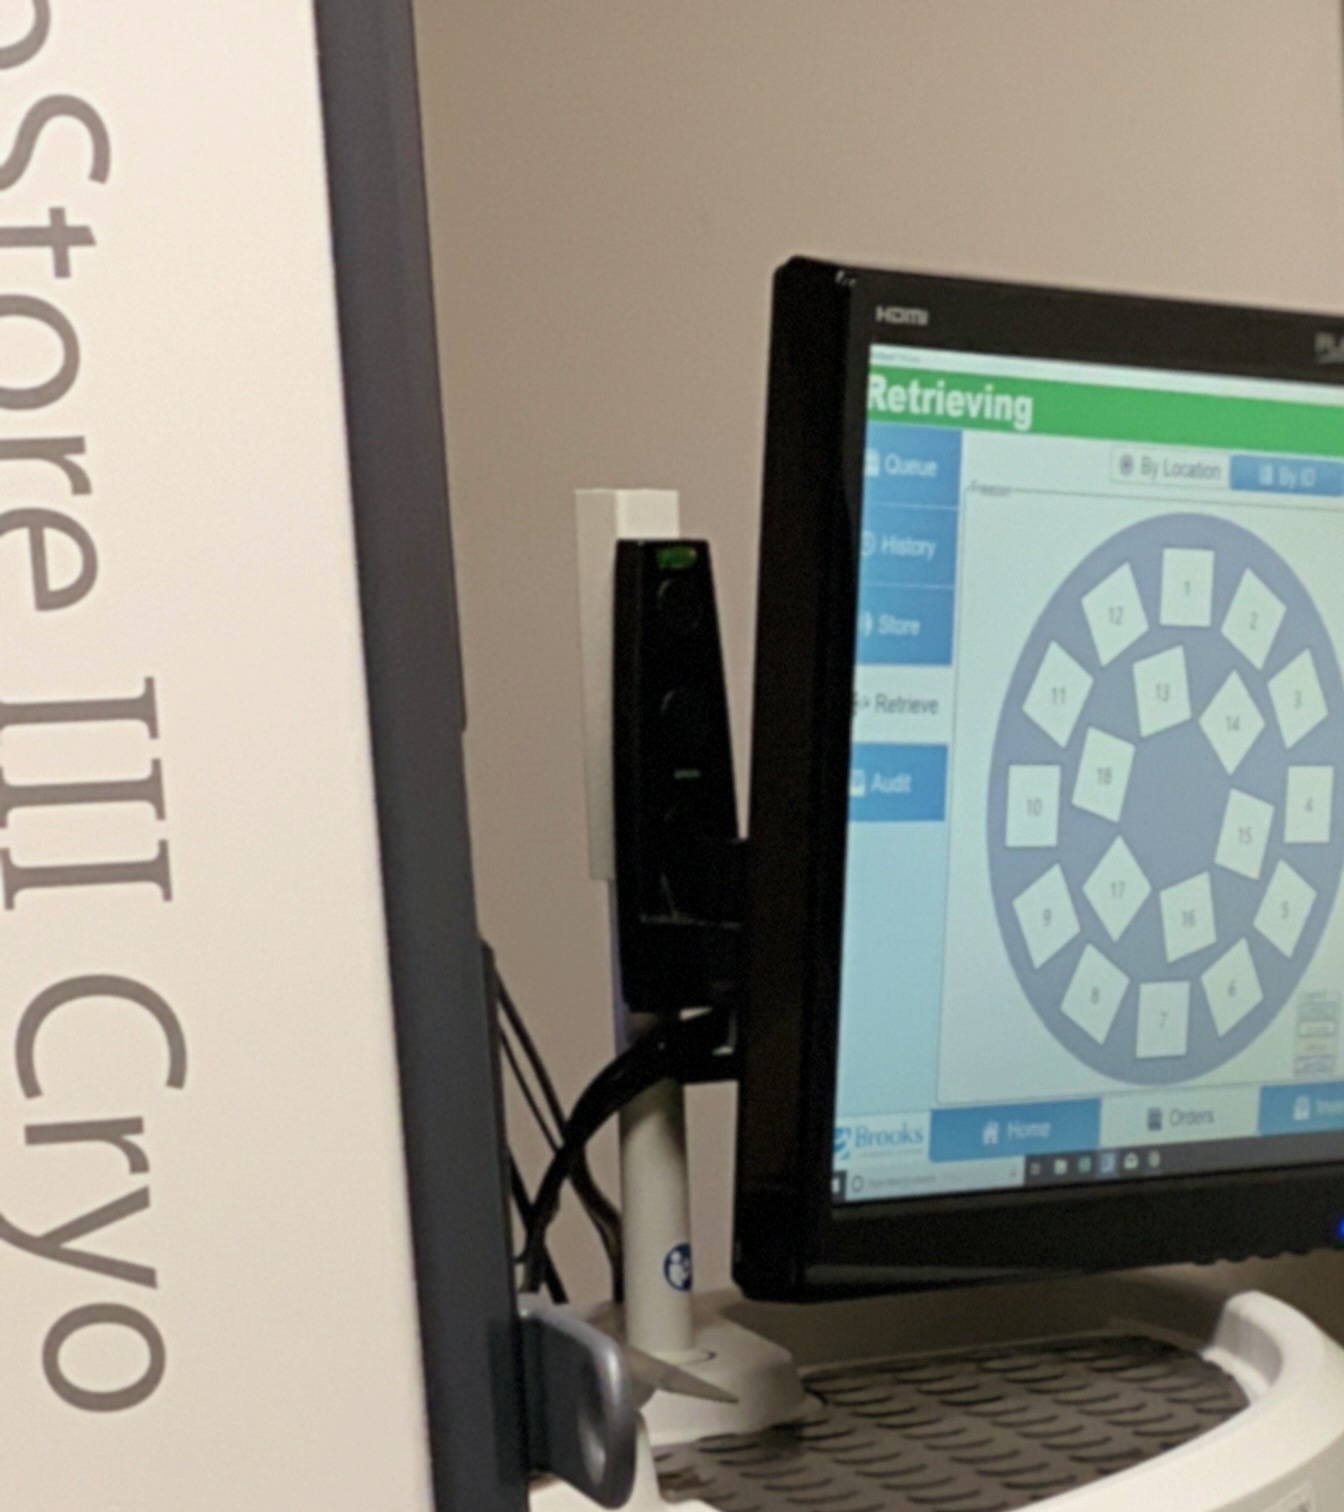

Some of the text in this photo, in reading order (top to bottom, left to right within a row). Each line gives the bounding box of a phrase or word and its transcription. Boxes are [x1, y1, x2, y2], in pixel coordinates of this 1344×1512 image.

[867, 373, 1034, 432] Retrieving
[884, 453, 938, 477] Queue
[1140, 455, 1222, 481] By Location
[881, 530, 936, 559] History
[1183, 579, 1191, 597] 1
[877, 613, 921, 636] Store
[1108, 606, 1124, 626] 12
[1249, 612, 1259, 630] 2
[1050, 687, 1067, 705] 11
[1155, 683, 1170, 701] 13
[0, 0, 188, 1413] Store III Cryo
[874, 693, 939, 715] Retrieve
[1225, 714, 1241, 733] 14
[870, 772, 912, 794] Audit
[1025, 798, 1042, 817] 10
[1304, 798, 1313, 815] 4
[1237, 827, 1252, 845] 15
[1110, 882, 1126, 899] 17
[1041, 908, 1052, 927] 9
[1182, 909, 1197, 928] 16
[1281, 900, 1290, 919] 5
[1227, 980, 1237, 998] 6
[1159, 1011, 1169, 1029] 7
[1169, 1106, 1214, 1128] Orders
[854, 1122, 924, 1149] Brooks
[1007, 1119, 1052, 1139] Home
